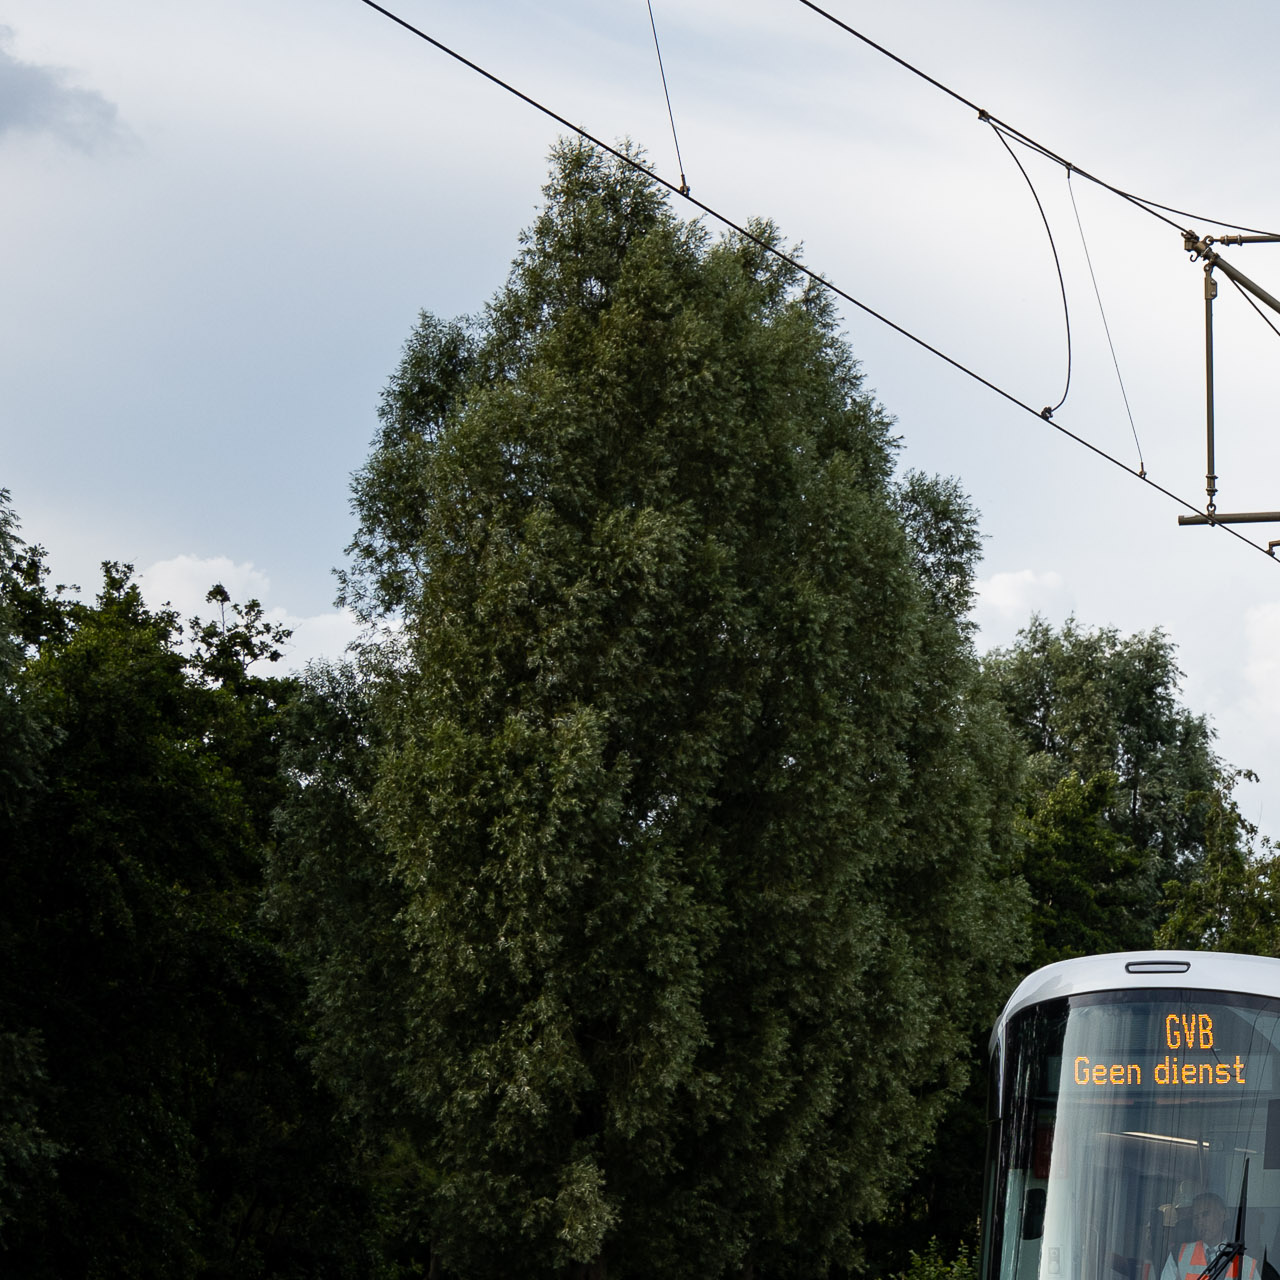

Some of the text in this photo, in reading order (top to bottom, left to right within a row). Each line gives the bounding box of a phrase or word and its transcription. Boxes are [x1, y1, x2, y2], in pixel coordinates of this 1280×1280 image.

[1165, 1013, 1214, 1049] GVB
[1074, 1055, 1246, 1085] Geen dienst
